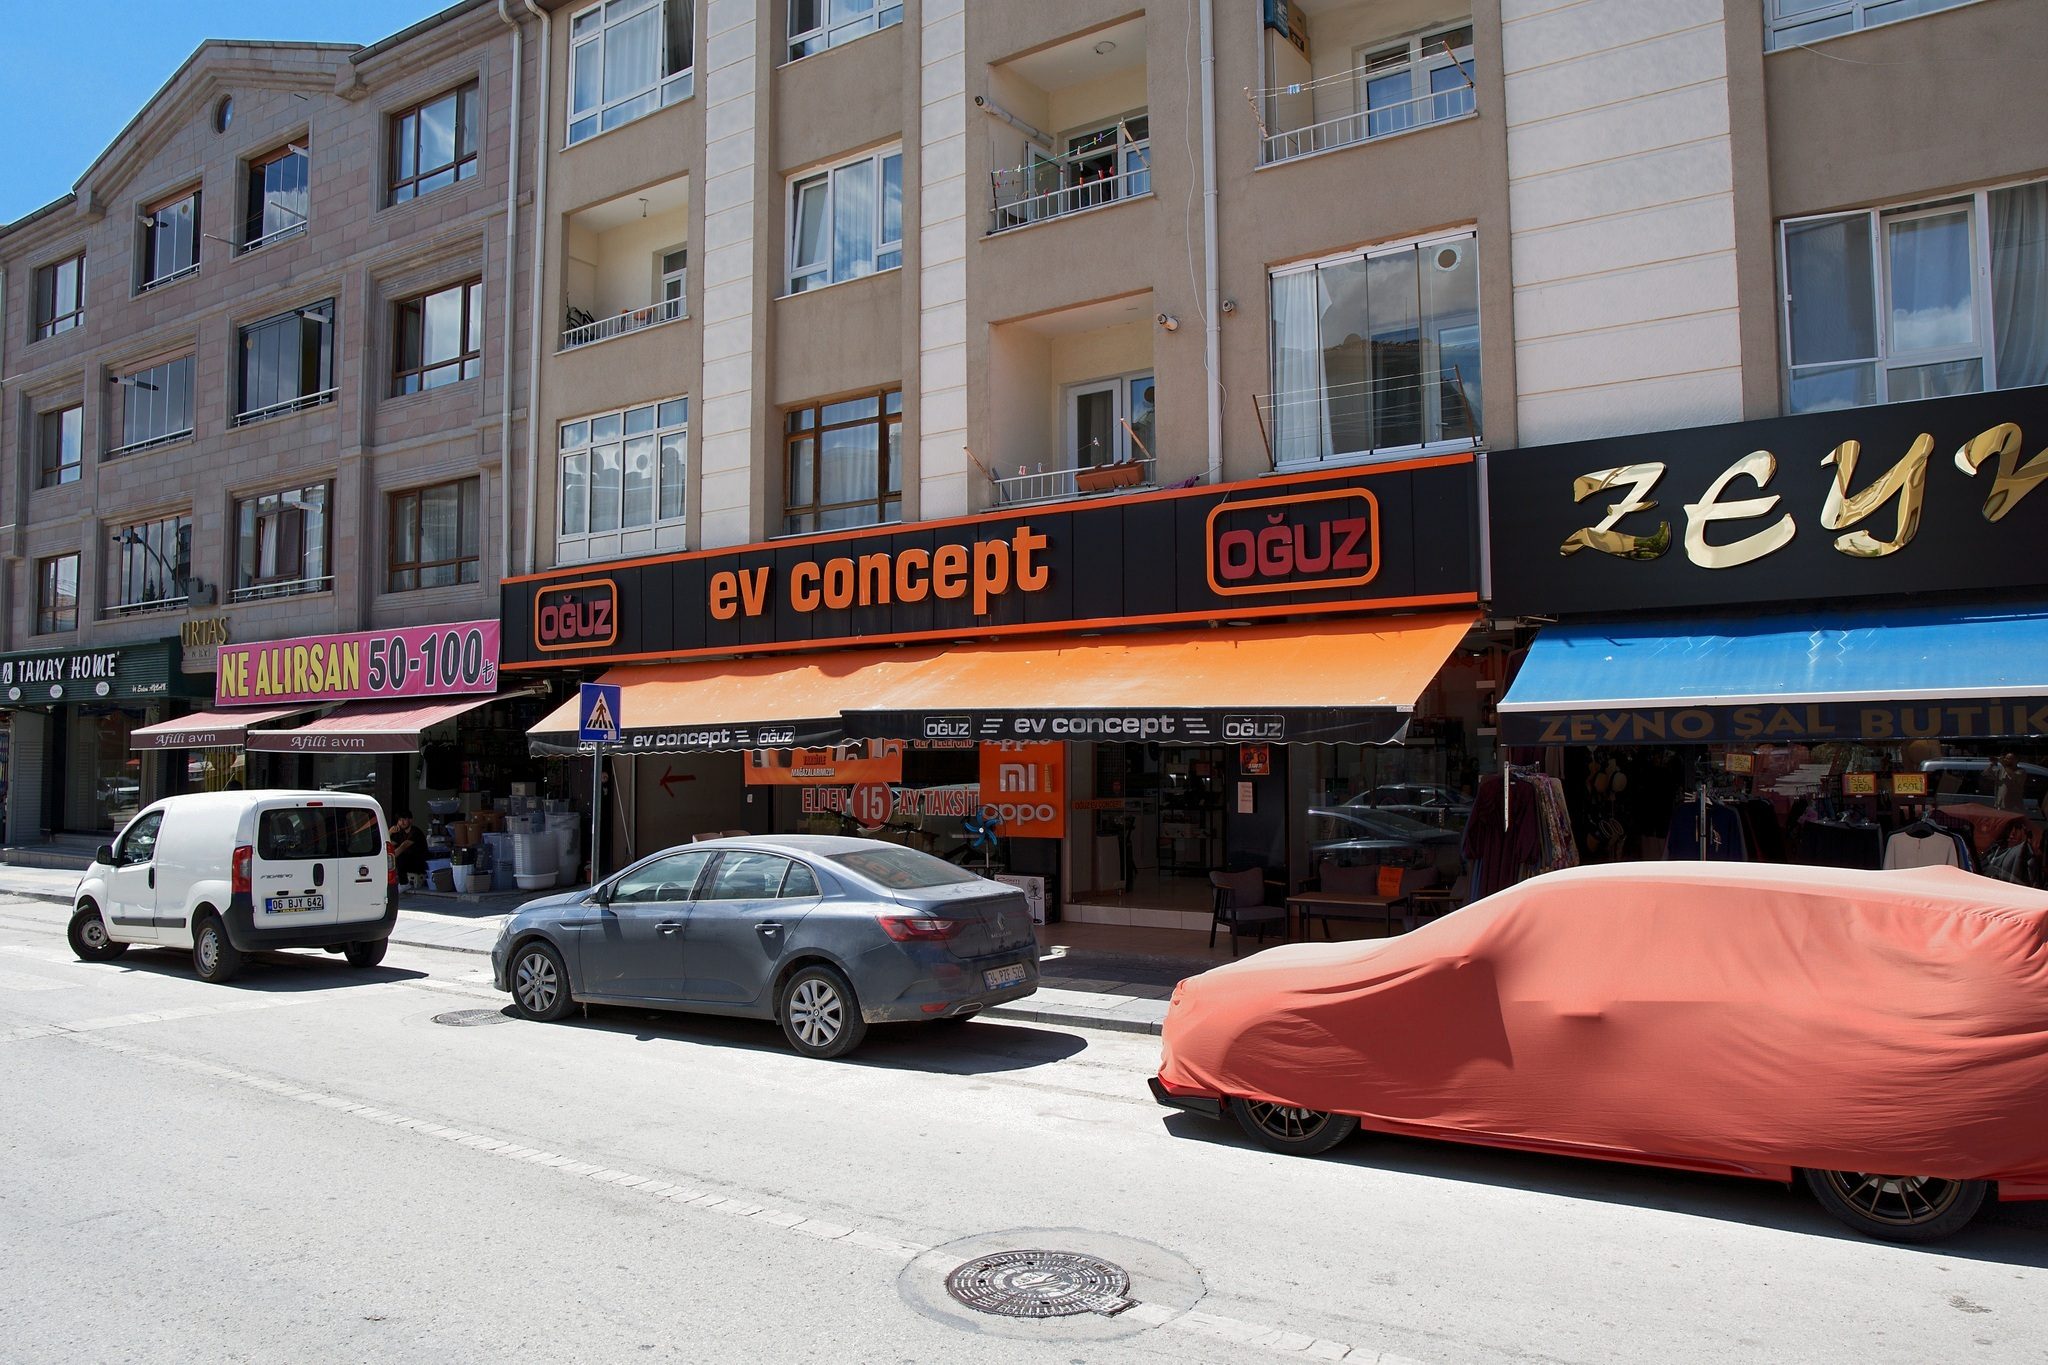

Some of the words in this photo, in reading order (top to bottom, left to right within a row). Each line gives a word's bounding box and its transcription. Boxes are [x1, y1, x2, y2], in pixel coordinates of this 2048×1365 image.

[1219, 512, 1368, 580] OĞUZ
[709, 565, 770, 620] ev
[790, 526, 1049, 615] concept
[540, 595, 612, 641] OĞUZ
[71, 652, 116, 679] HOME
[221, 651, 249, 698] NE
[255, 640, 359, 697] ALIRSAN
[926, 718, 969, 736] OĞUZ
[1014, 717, 1047, 734] ev
[1052, 715, 1175, 739] concept
[1225, 717, 1283, 737] OĞUZ
[1538, 708, 1714, 742] ZEYNO
[1734, 704, 1837, 741] ŞAL
[155, 732, 186, 745] Afilli
[188, 731, 216, 743] avm
[290, 735, 326, 748] Afilli
[331, 737, 365, 748] avm
[633, 735, 654, 748] ev
[656, 729, 730, 748] concept
[759, 728, 793, 744] OĞUZ
[802, 787, 849, 813] ELDEN
[860, 786, 883, 820] 15
[898, 788, 921, 816] AY
[923, 785, 979, 817] TAKSİT
[983, 803, 1055, 826] oppo
[273, 899, 283, 910] 06
[288, 898, 303, 908] BJY
[307, 896, 322, 907] 642
